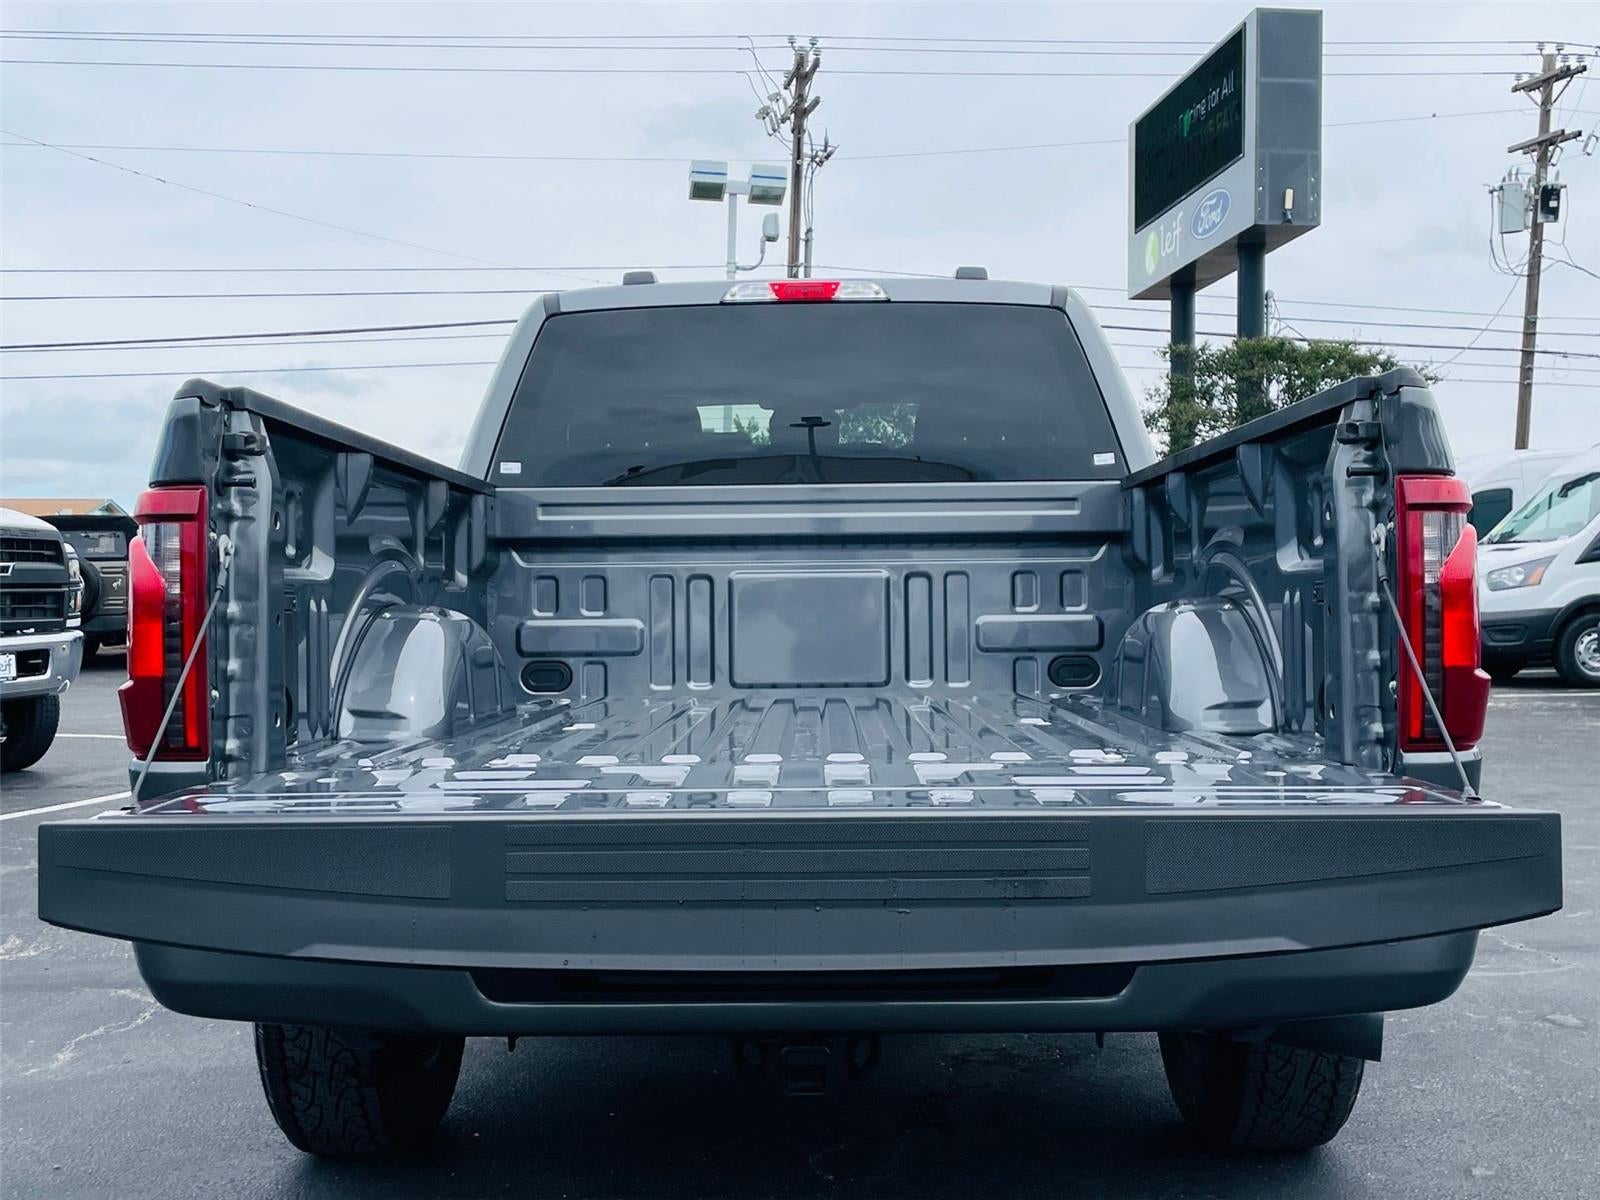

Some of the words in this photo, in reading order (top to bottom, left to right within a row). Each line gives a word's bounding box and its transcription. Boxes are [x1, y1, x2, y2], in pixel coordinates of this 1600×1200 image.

[1221, 70, 1234, 100] All
[1198, 197, 1223, 233] Ford
[1160, 210, 1183, 257] leif
